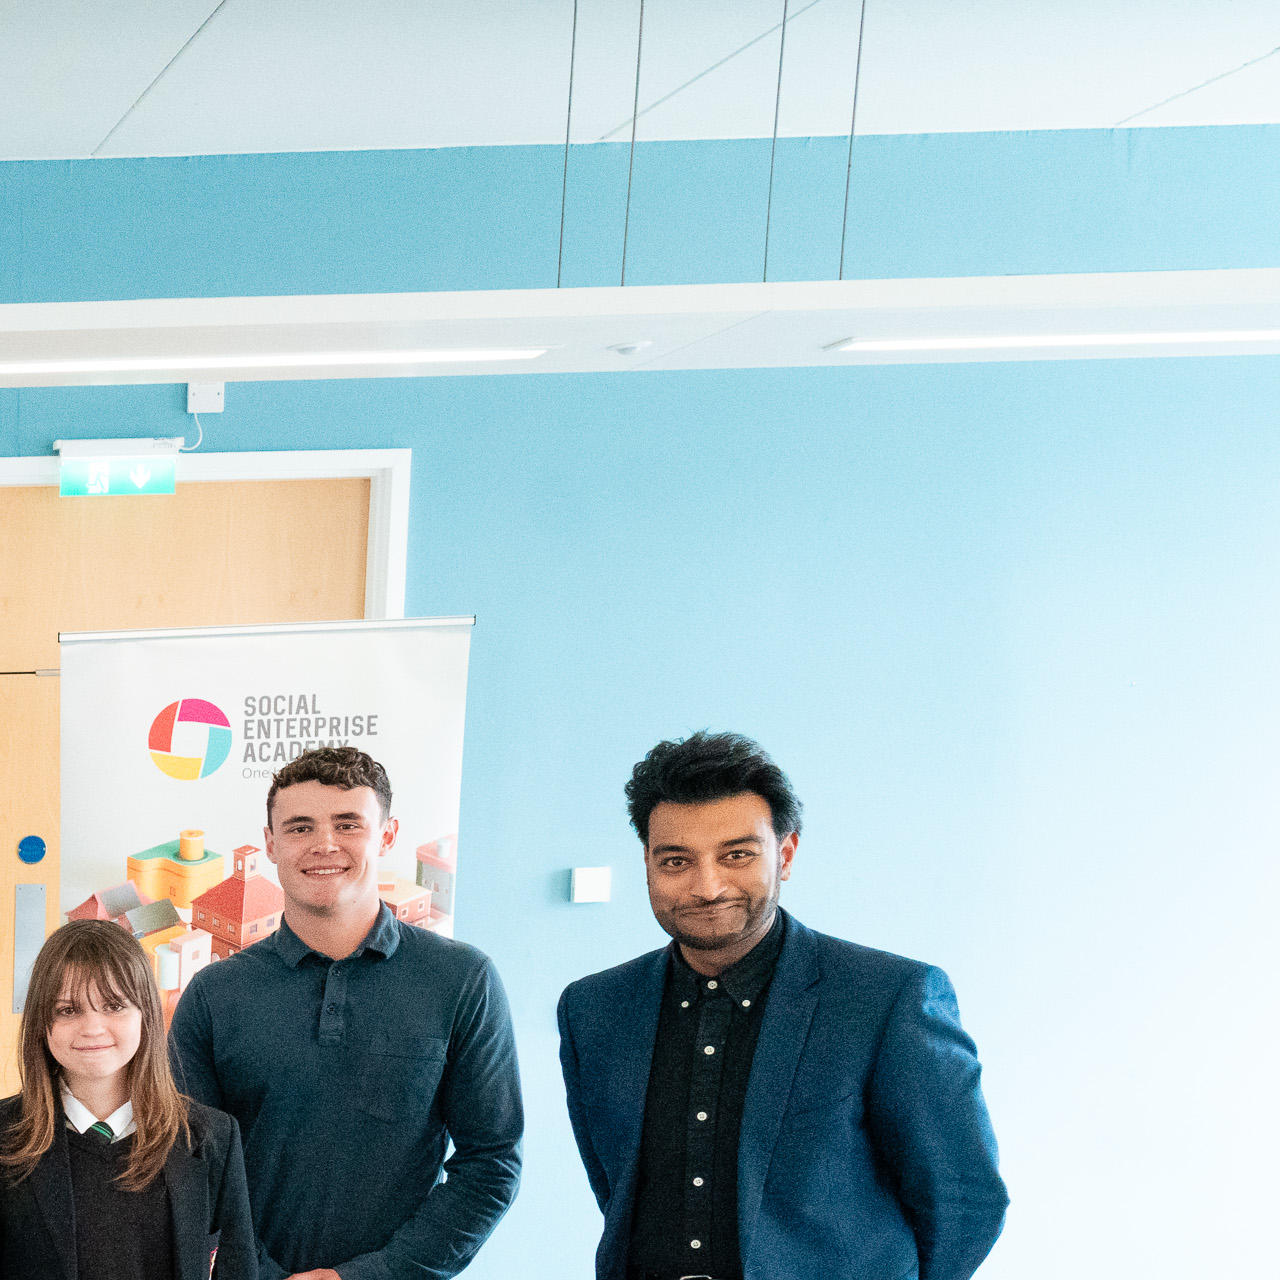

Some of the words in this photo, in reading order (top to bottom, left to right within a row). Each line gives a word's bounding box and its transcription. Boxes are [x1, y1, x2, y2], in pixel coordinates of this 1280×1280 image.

[244, 694, 321, 717] SOCIAL
[243, 715, 378, 740] ENTERPRISE
[242, 767, 270, 779] One
